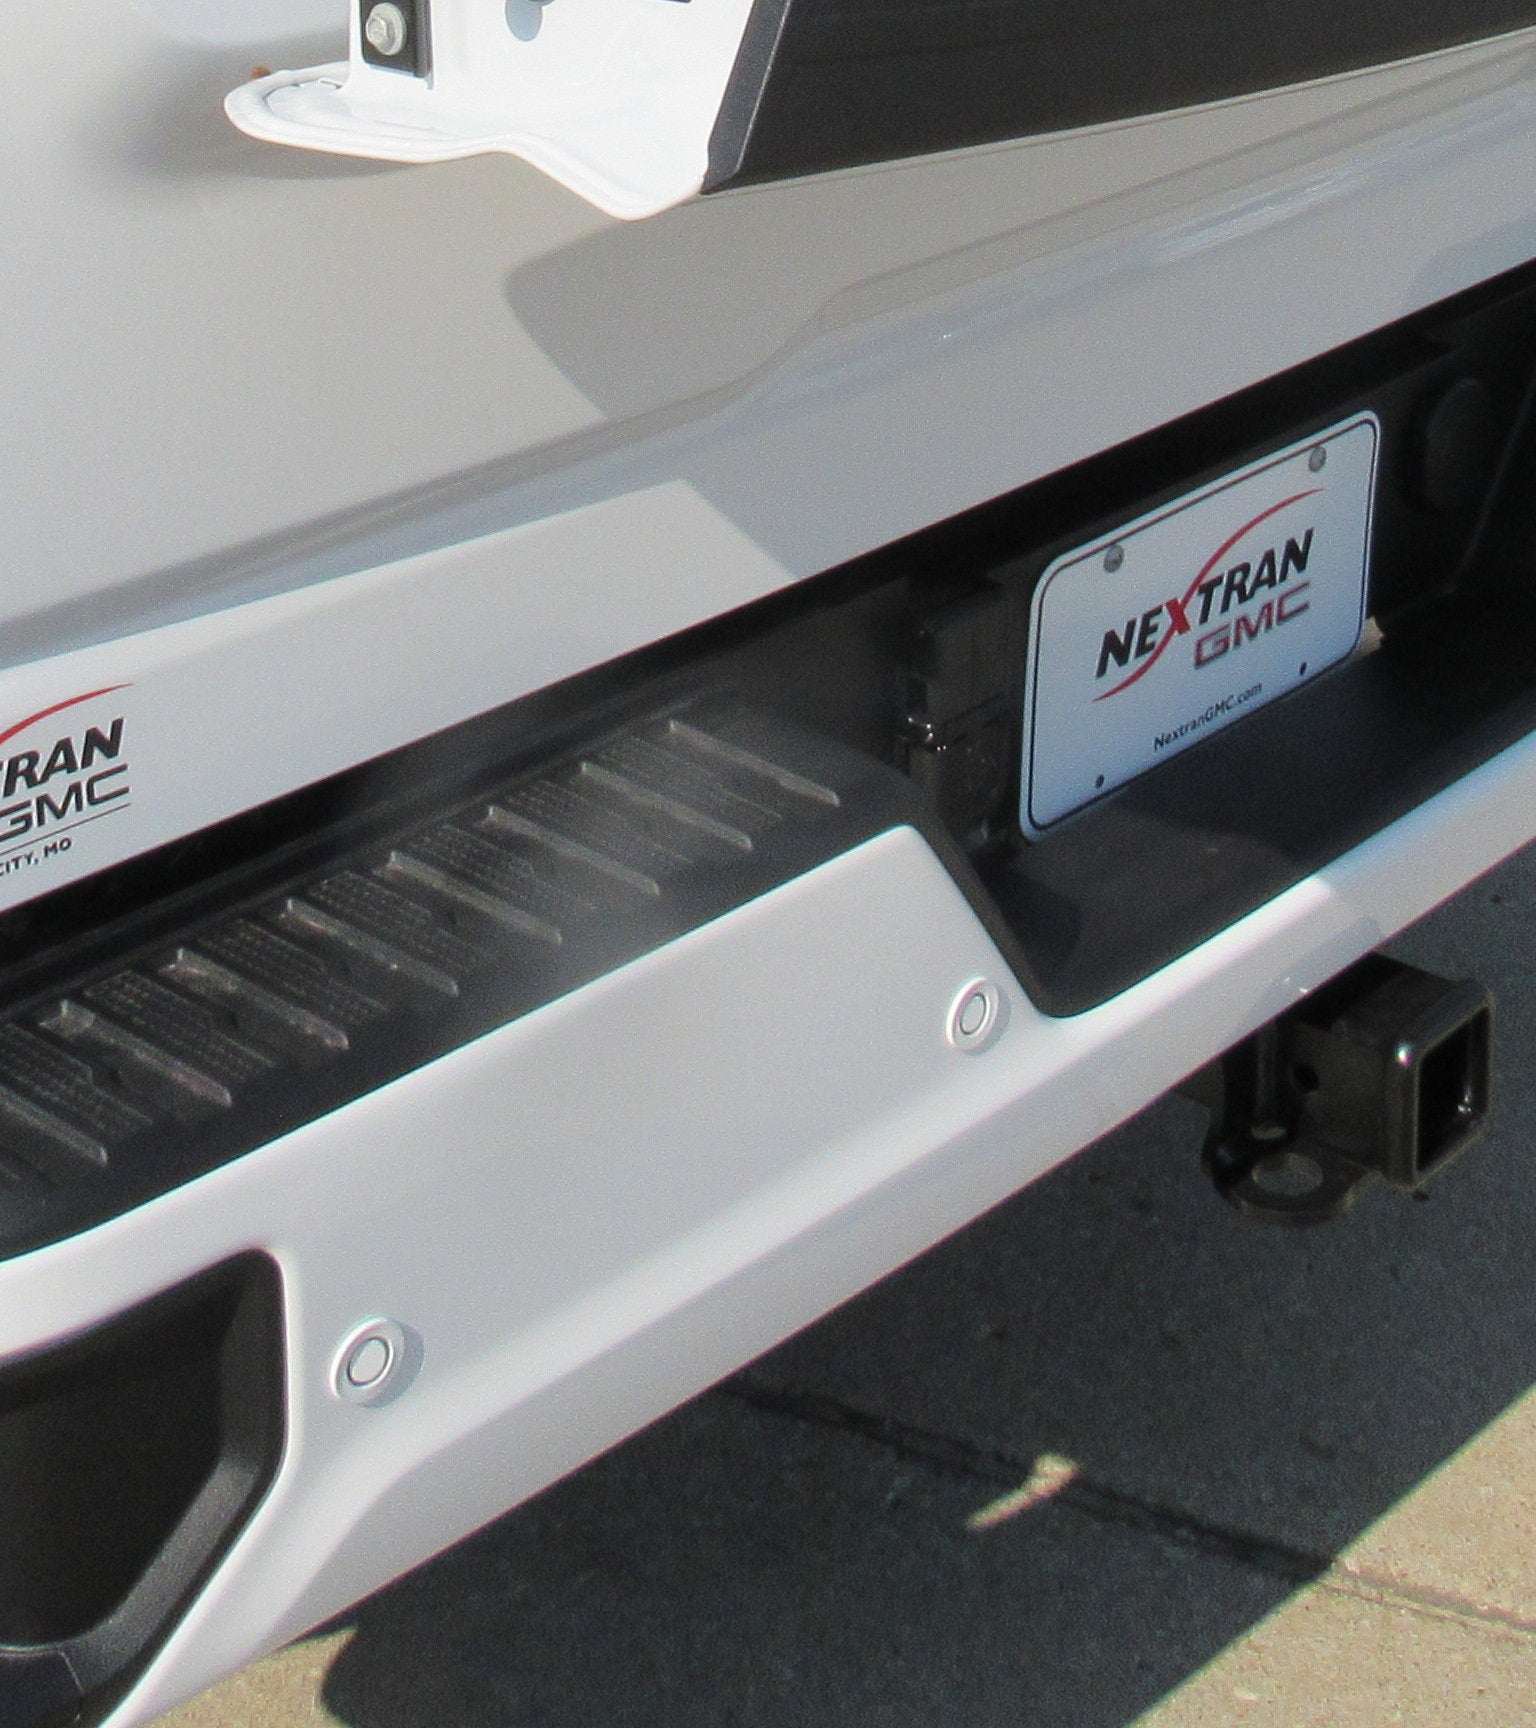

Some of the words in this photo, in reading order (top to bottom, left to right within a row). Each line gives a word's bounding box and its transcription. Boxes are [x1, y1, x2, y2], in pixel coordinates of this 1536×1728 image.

[1095, 527, 1314, 679] NEXTRAN
[1192, 581, 1311, 669] GMC
[1154, 682, 1263, 753] NextranGMC.com
[43, 836, 72, 860] MO
